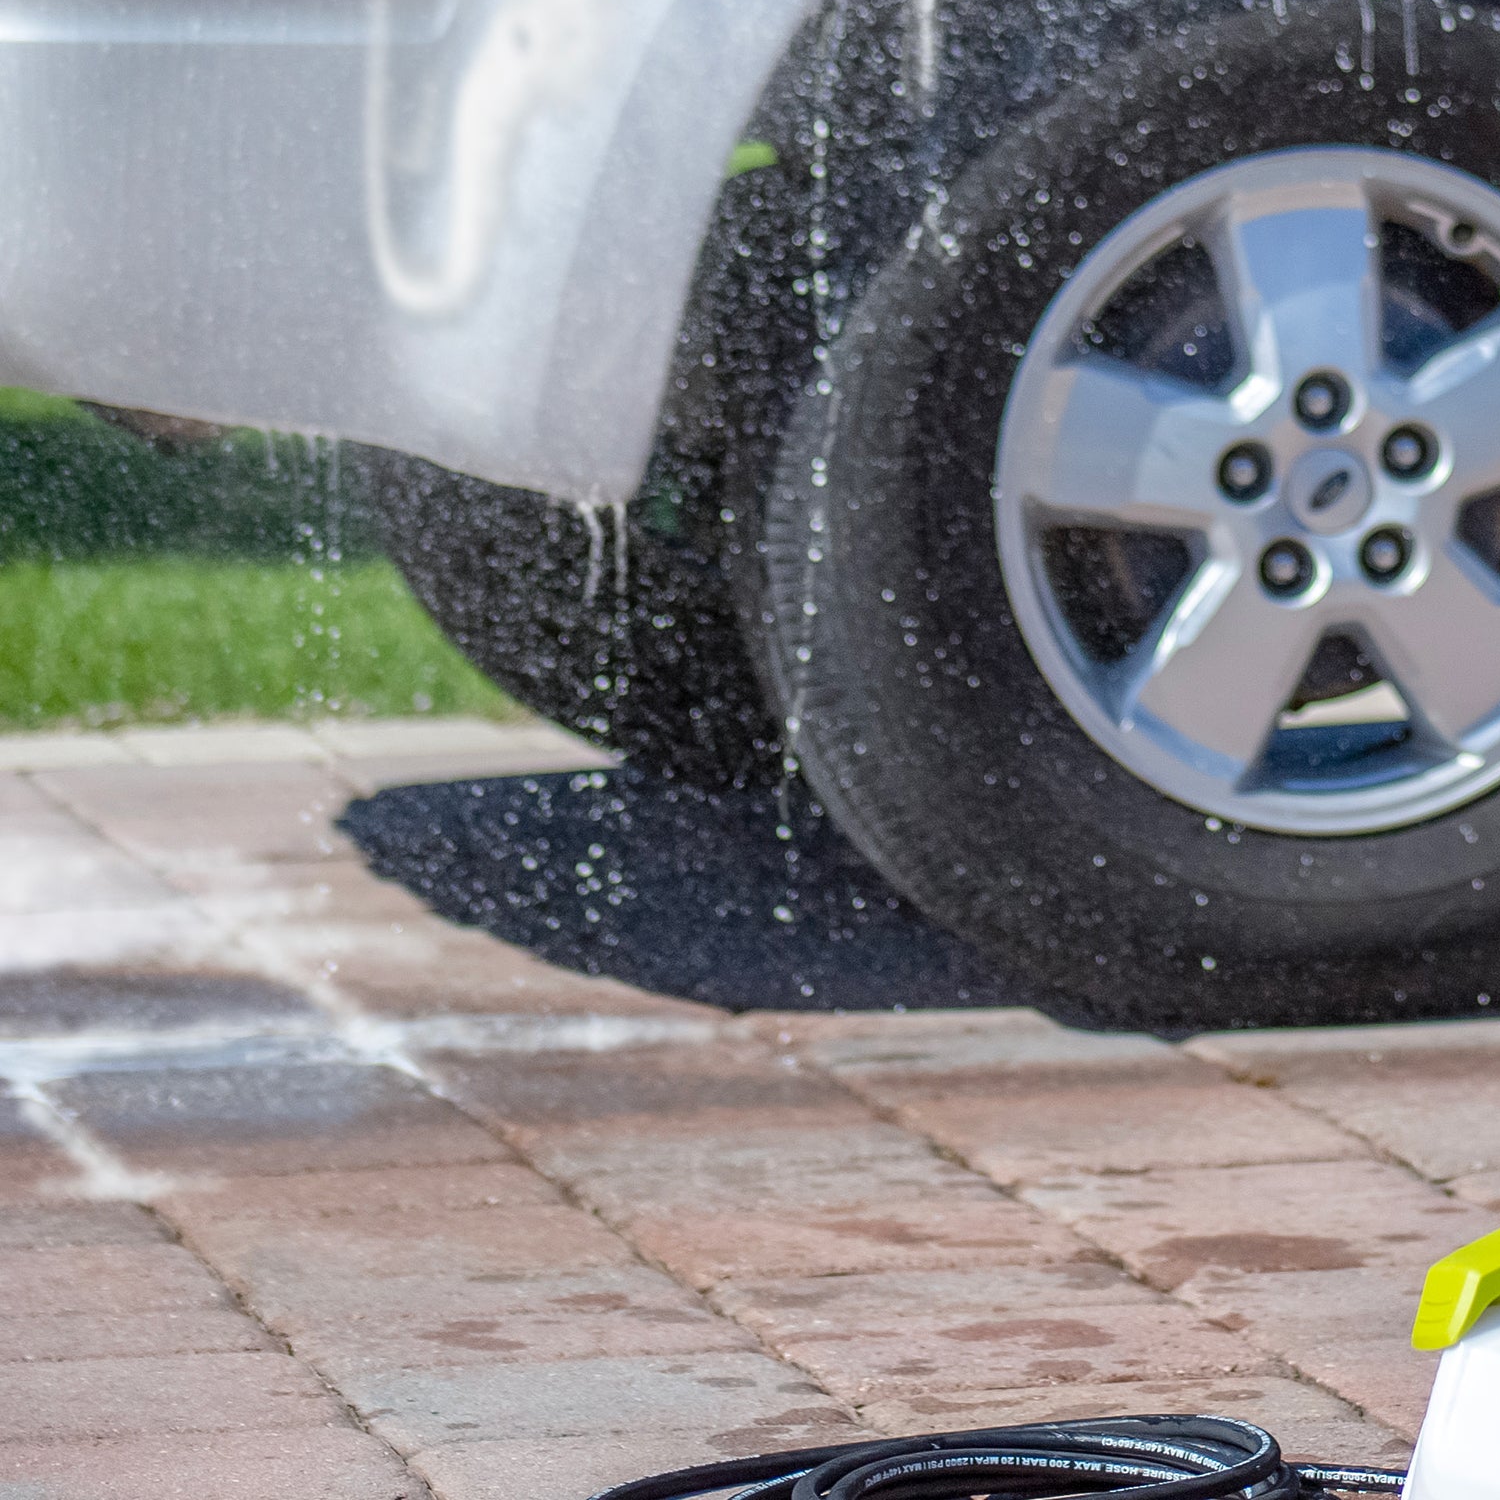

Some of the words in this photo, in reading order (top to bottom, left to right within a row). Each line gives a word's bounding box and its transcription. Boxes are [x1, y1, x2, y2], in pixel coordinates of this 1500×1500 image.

[1163, 1446, 1184, 1459] MAX
[1188, 1452, 1204, 1464] PSI
[927, 1459, 944, 1470] PSI
[975, 1456, 1000, 1466] MPA
[1001, 1456, 1015, 1466] 20
[1021, 1456, 1048, 1467] BAR
[1048, 1459, 1071, 1469] 200
[1073, 1460, 1102, 1472] MAX
[902, 1461, 923, 1473] MAX
[1105, 1464, 1139, 1475] HOSE
[1321, 1470, 1340, 1481] PSI
[1372, 1473, 1397, 1485] MPA
